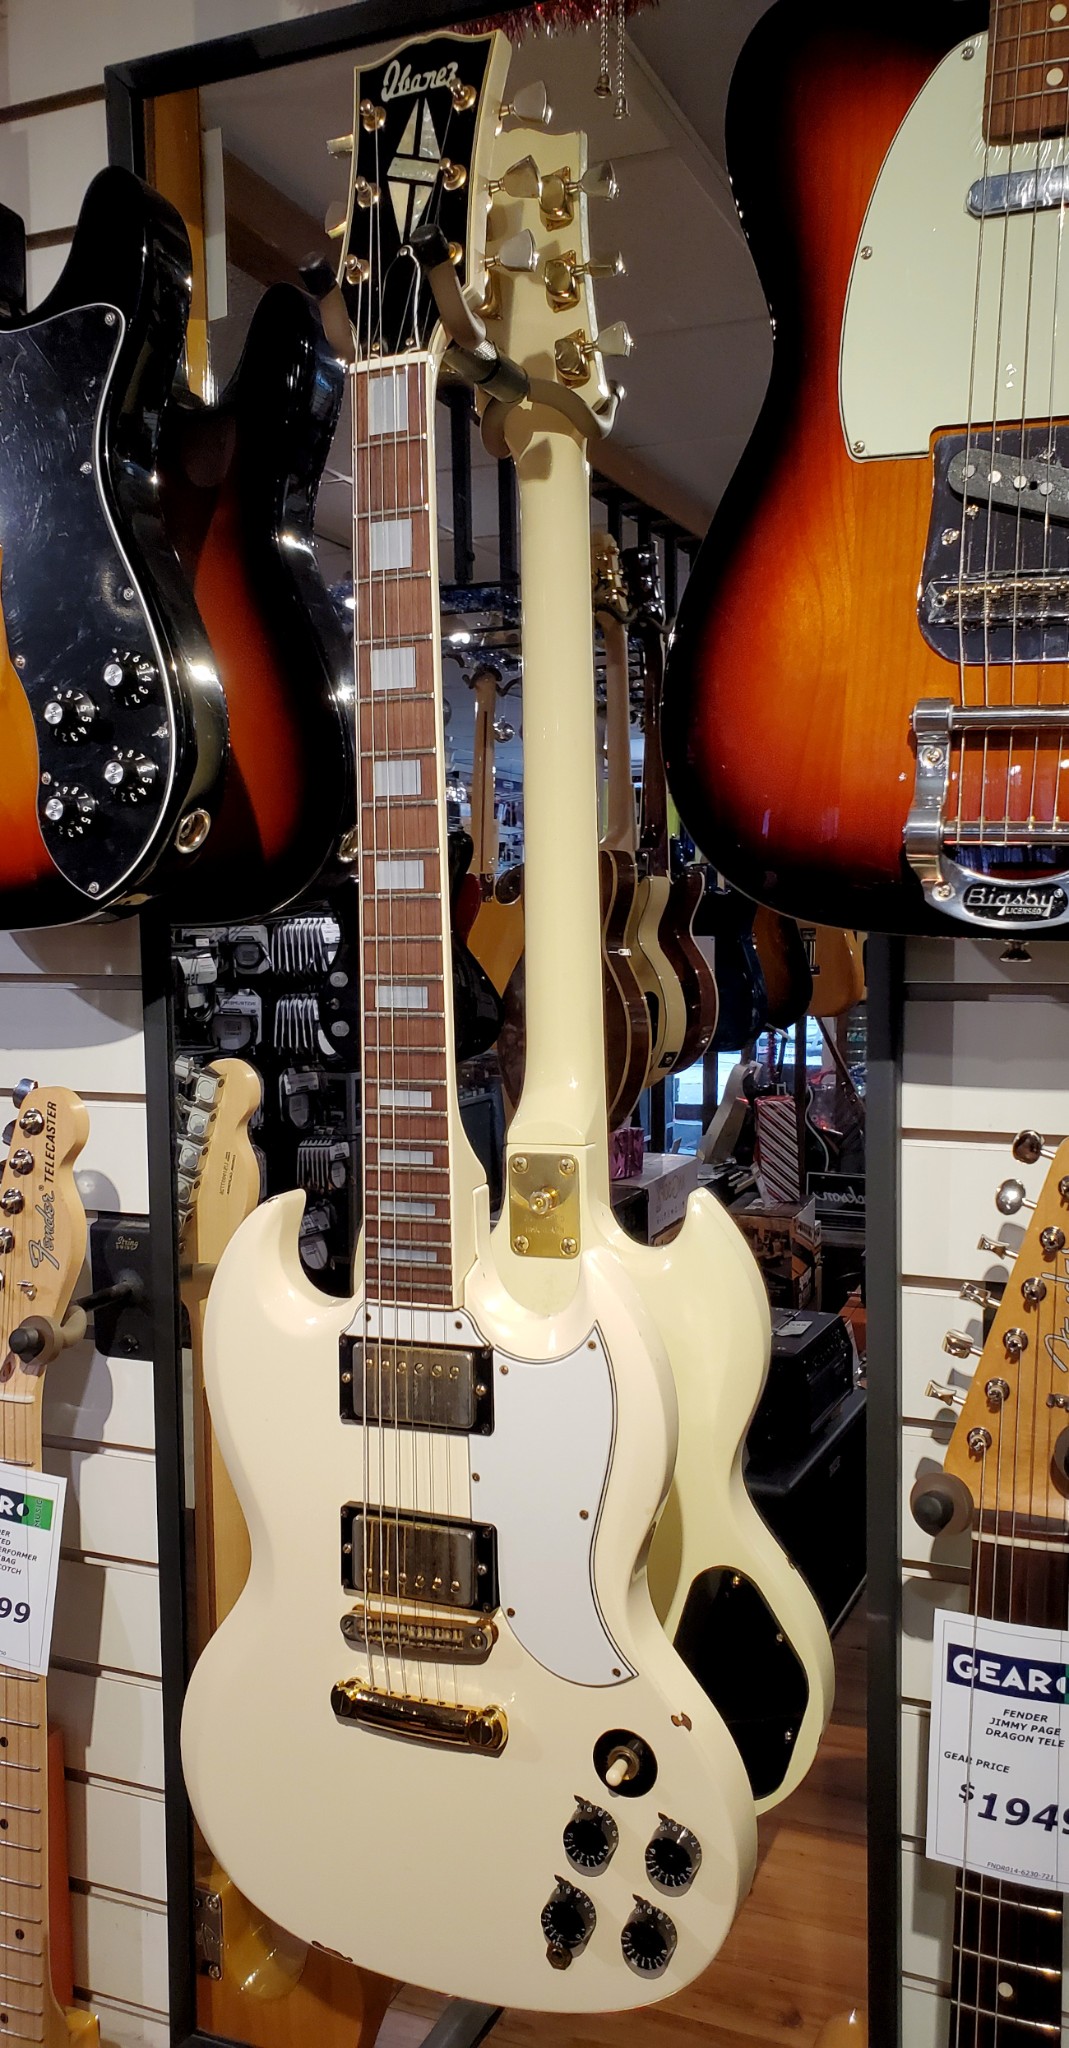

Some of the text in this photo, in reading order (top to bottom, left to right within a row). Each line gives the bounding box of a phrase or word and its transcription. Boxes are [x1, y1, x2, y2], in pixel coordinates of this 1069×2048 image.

[381, 60, 459, 102] Ibanez
[966, 887, 1054, 917] Bigsby
[1005, 907, 1043, 915] LICENSED
[44, 1101, 57, 1183] TELECASTER
[28, 1191, 60, 1270] Fender
[952, 1654, 1052, 1694] GEAR
[989, 1717, 1061, 1736] JIMMY PAGE
[1003, 1709, 1048, 1722] FENDER
[986, 1728, 1065, 1748] DRAGON TELE
[944, 1751, 1010, 1773] GEAR PRICE
